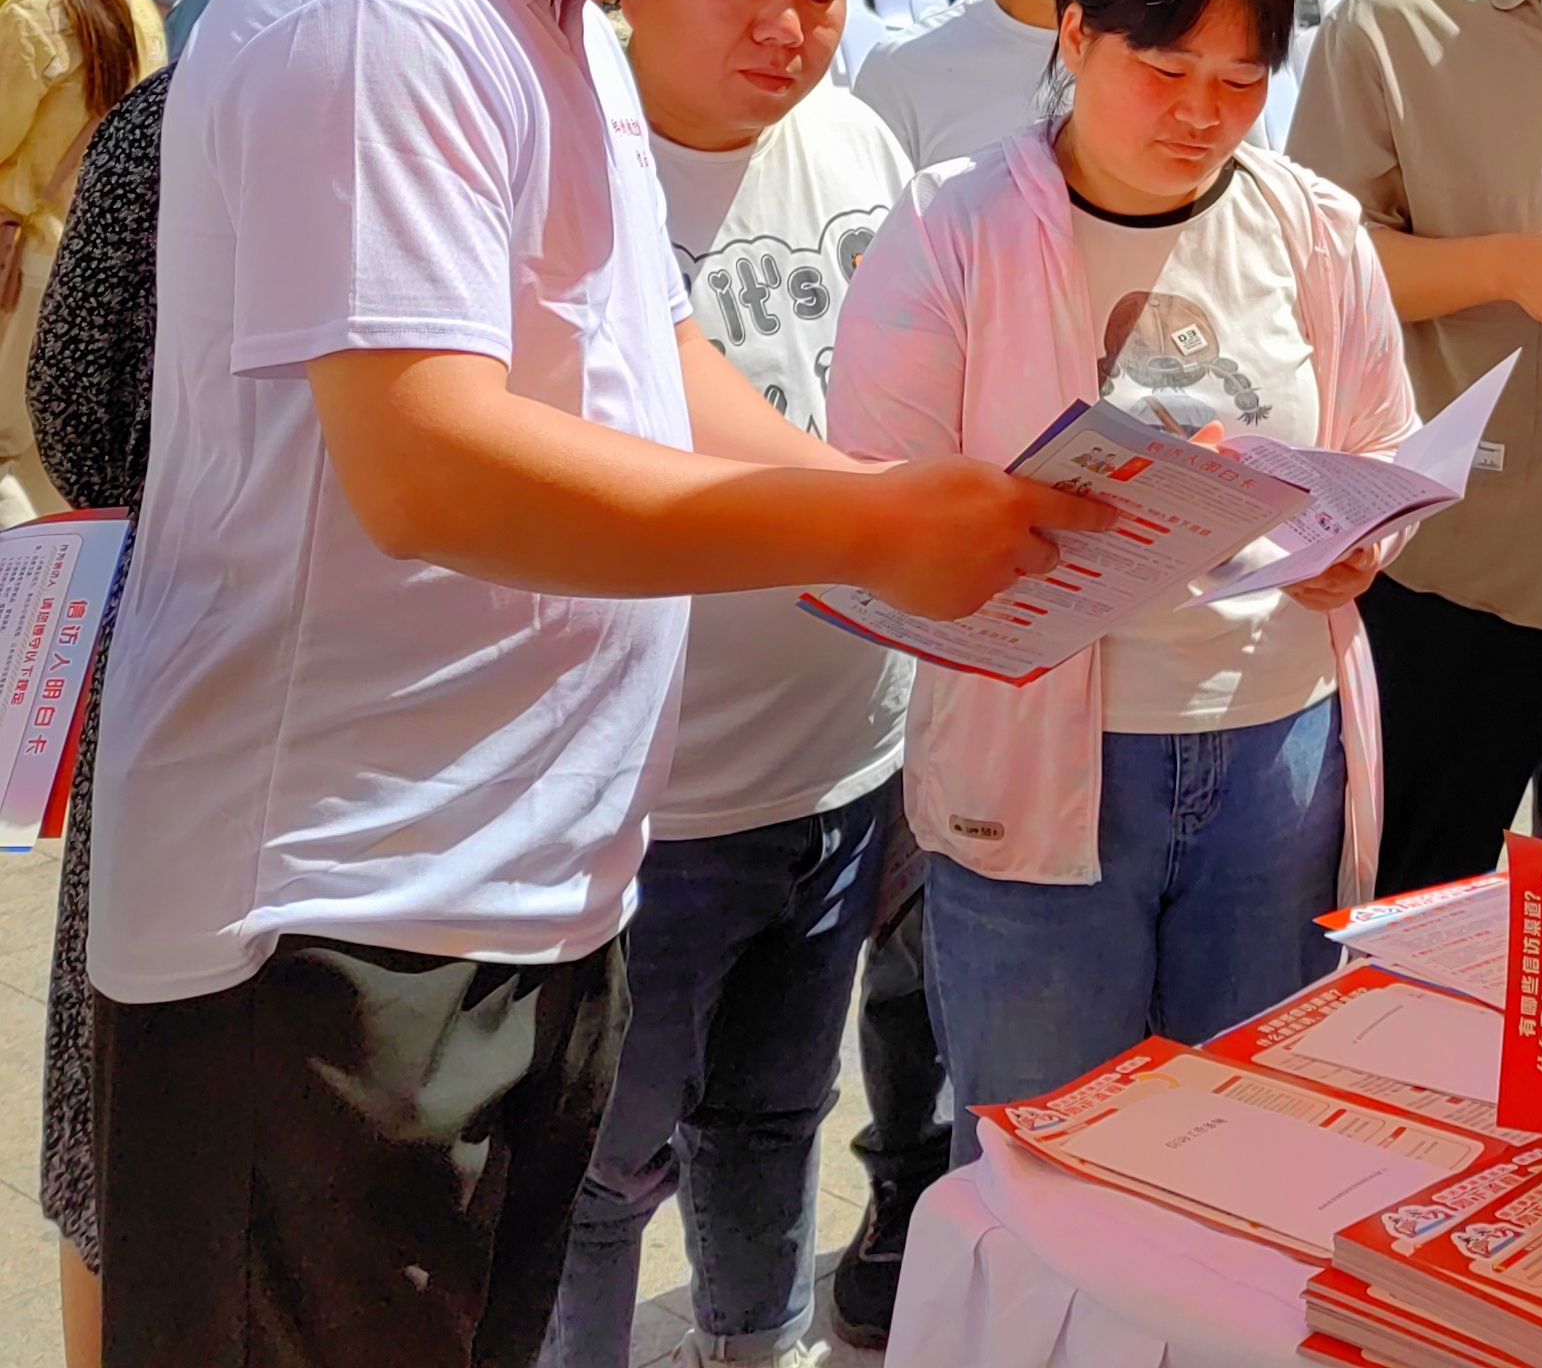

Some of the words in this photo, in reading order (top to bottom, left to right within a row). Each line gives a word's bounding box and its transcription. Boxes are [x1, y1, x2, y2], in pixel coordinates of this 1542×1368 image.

[708, 254, 831, 346] it's
[25, 599, 88, 755] 信访人明白卡
